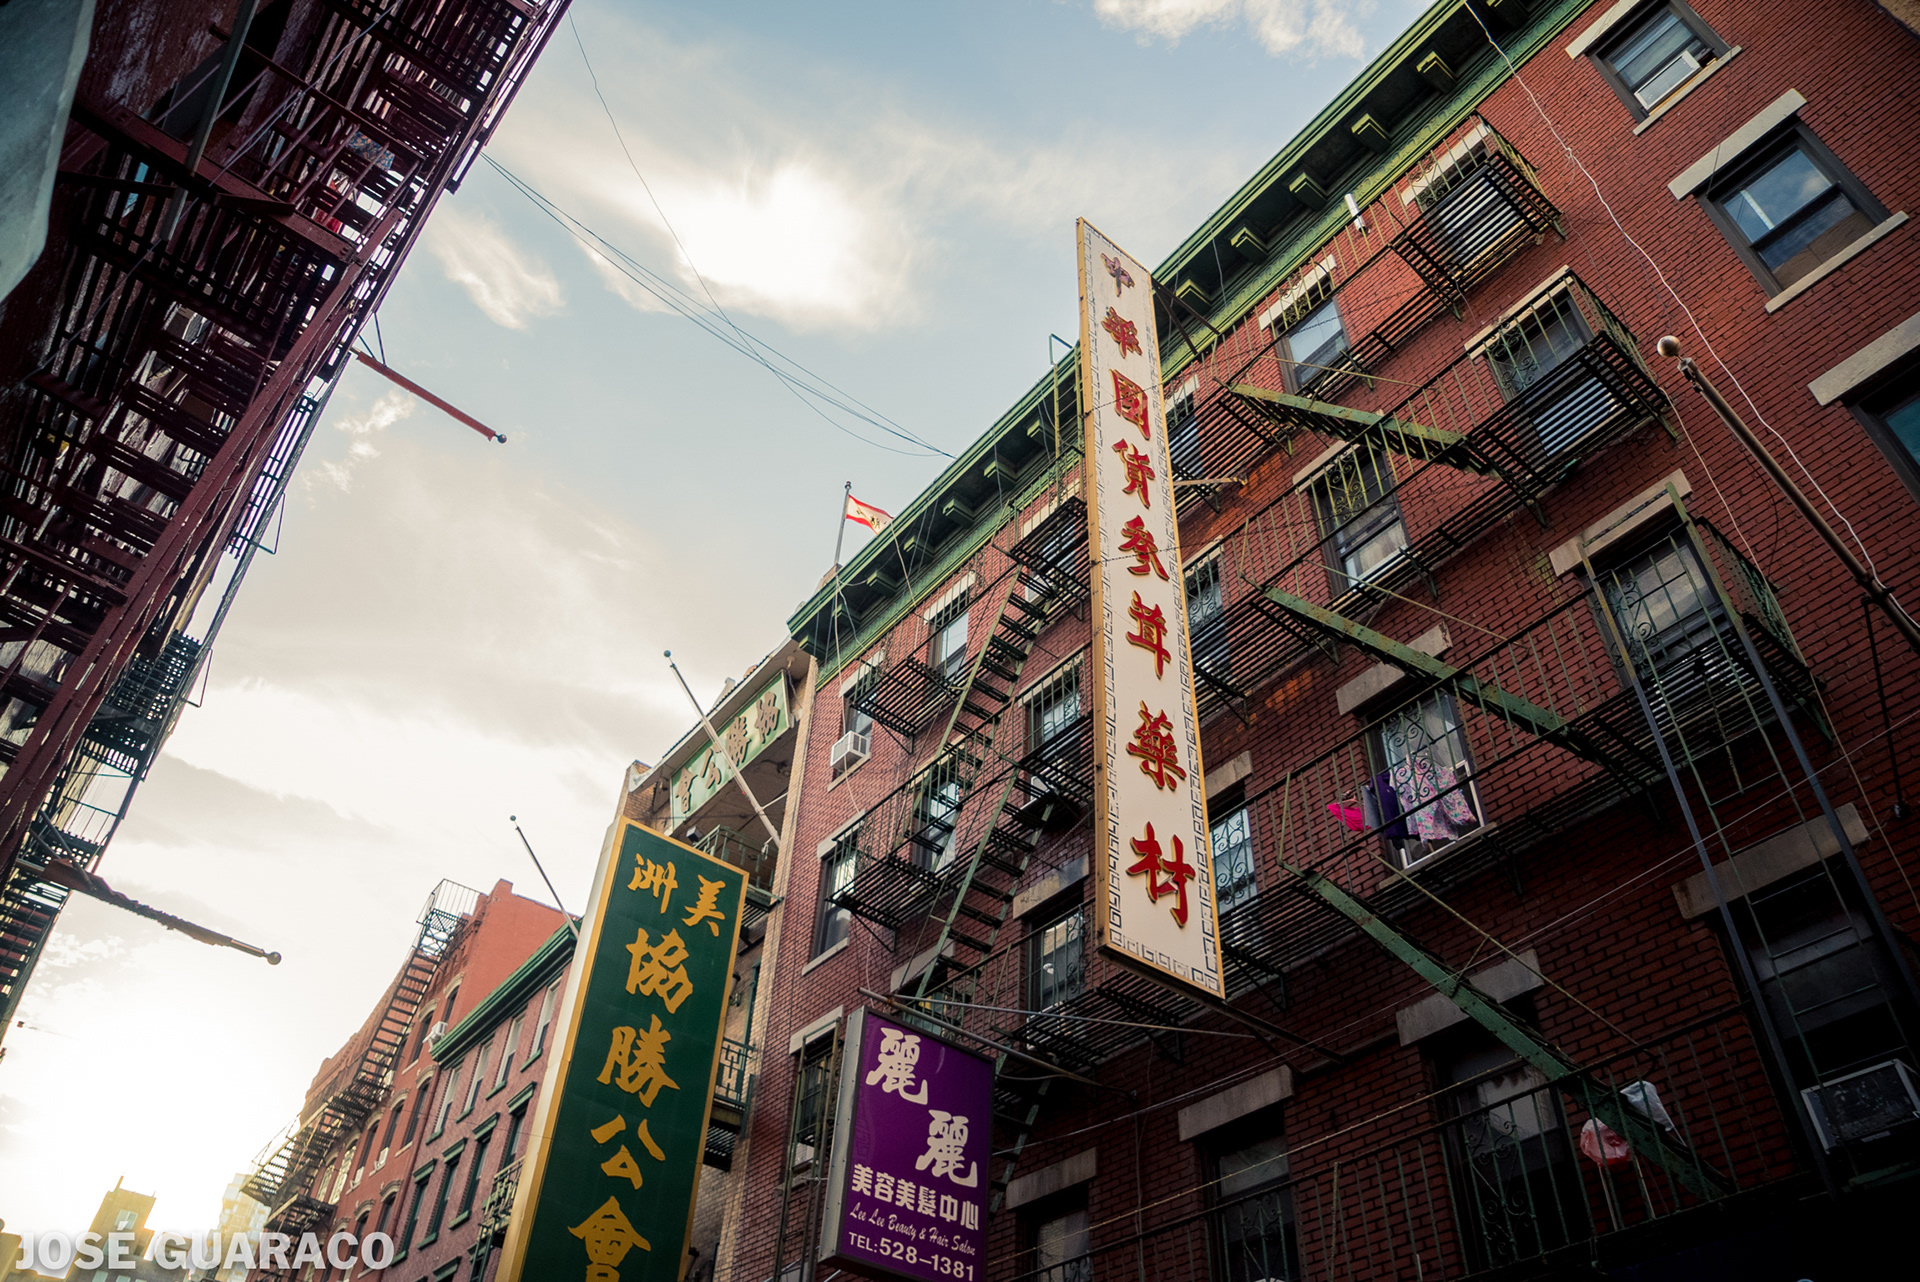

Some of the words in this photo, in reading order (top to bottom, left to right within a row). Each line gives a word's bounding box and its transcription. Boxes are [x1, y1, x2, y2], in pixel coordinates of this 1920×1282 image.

[851, 1163, 979, 1231] 美容美髮中心
[850, 1202, 866, 1221] Lee
[868, 1208, 885, 1228] Lee
[888, 1214, 917, 1241] Beauty
[919, 1228, 926, 1240] &
[929, 1227, 949, 1248] Hair
[951, 1235, 976, 1256] Salon
